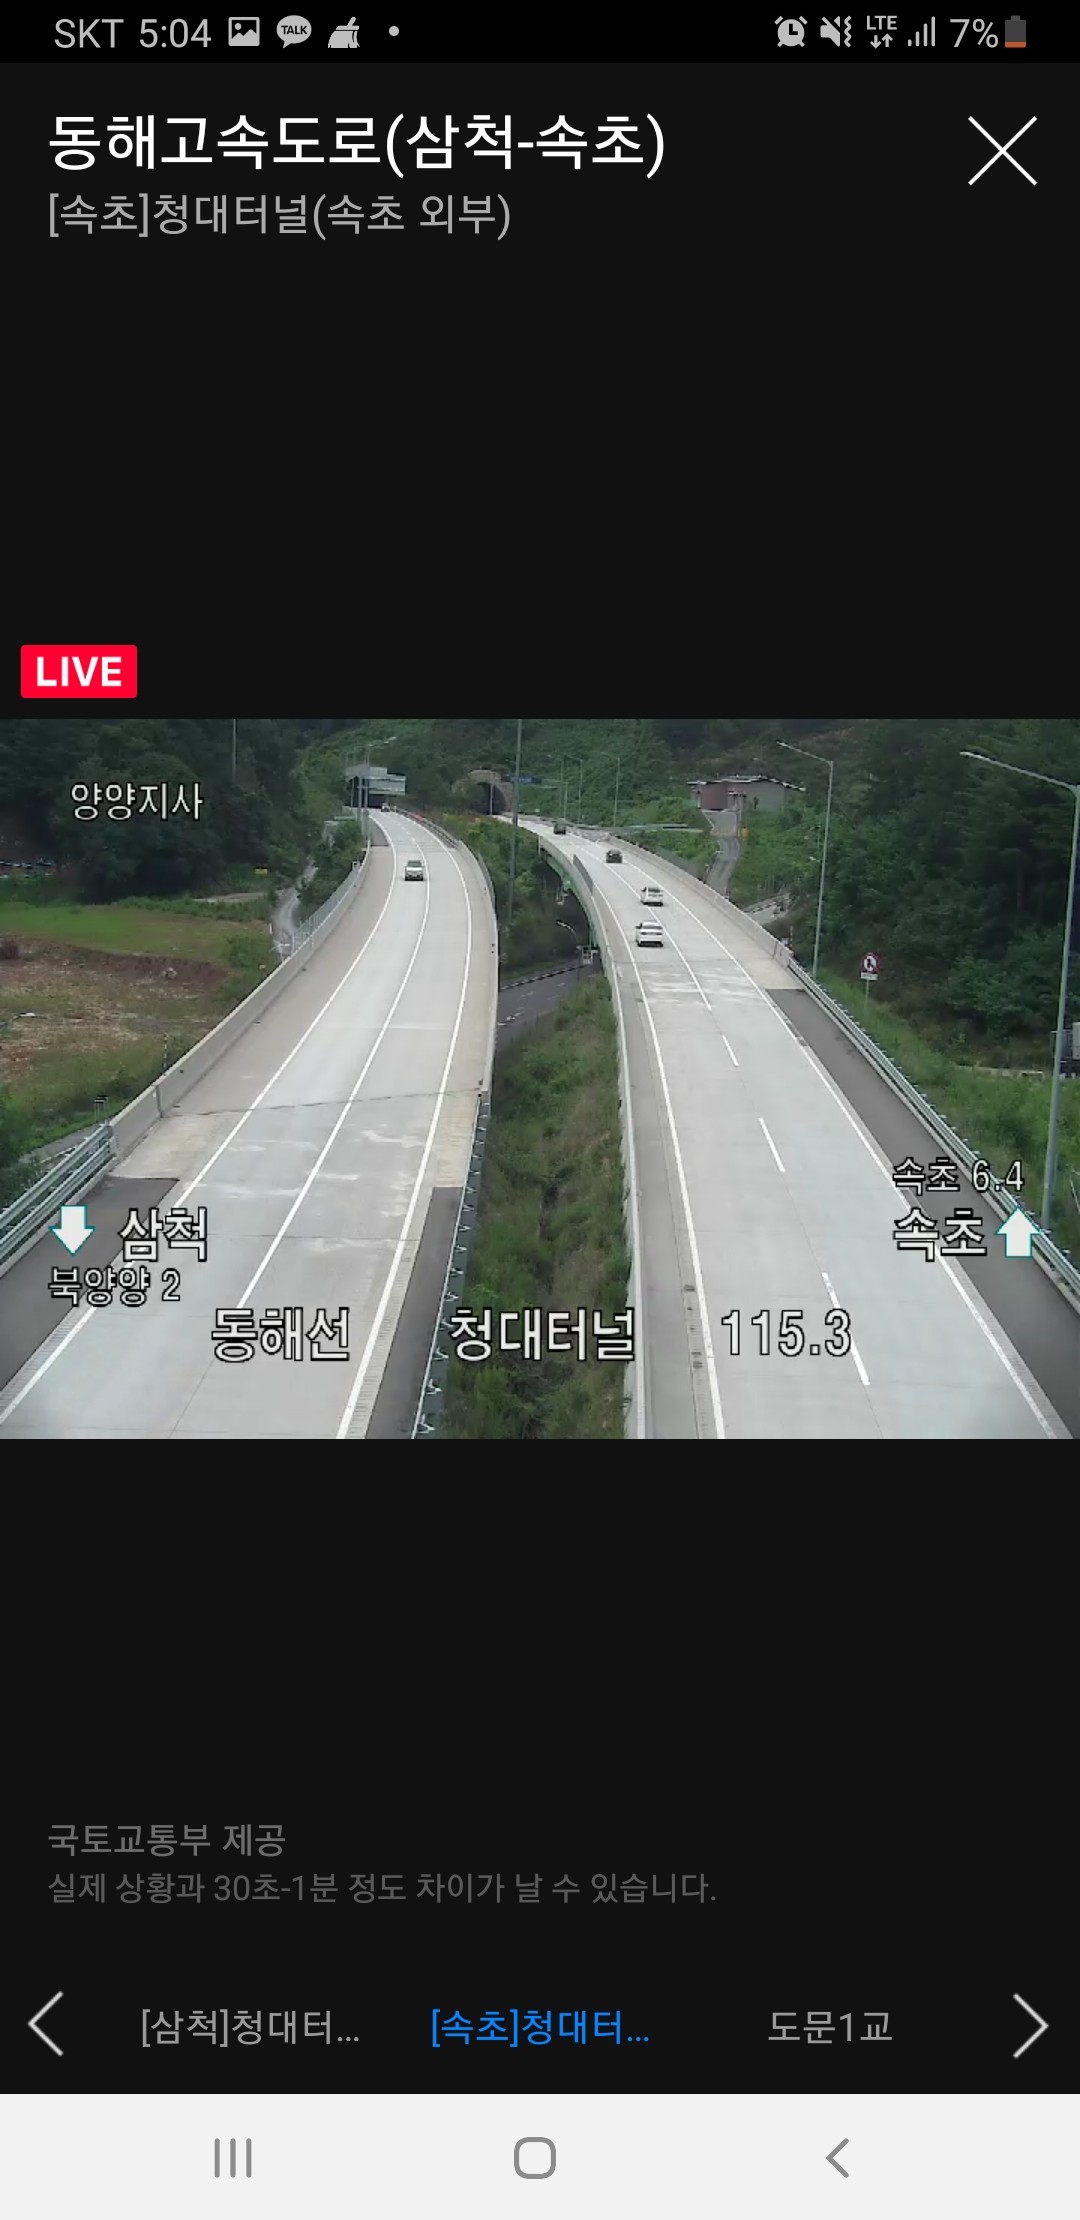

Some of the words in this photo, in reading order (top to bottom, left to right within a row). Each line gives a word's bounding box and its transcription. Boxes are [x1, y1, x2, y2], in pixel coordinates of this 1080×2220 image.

[54, 18, 125, 49] SKT
[139, 18, 212, 48] 5:04
[280, 25, 308, 35] TALK
[866, 15, 898, 29] LTE
[949, 18, 999, 49] 7%
[48, 112, 665, 179] 동해고속도로(삼척-속초)
[49, 192, 405, 241] [속초]청대터널(속초
[419, 193, 512, 241] 외부)
[36, 656, 122, 687] LIVE
[47, 1824, 211, 1858] 국토교통부
[222, 1823, 286, 1858] 제공
[48, 1873, 107, 1904] 실제
[115, 1872, 206, 1904] 상황과
[214, 1873, 339, 1903] 30초-1분
[348, 1873, 407, 1904] 정도
[416, 1873, 505, 1904] 차이가
[515, 1873, 543, 1904] 날
[551, 1873, 581, 1904] 수
[591, 1873, 716, 1904] 있습니다.
[768, 2009, 893, 2045] 도문1교
